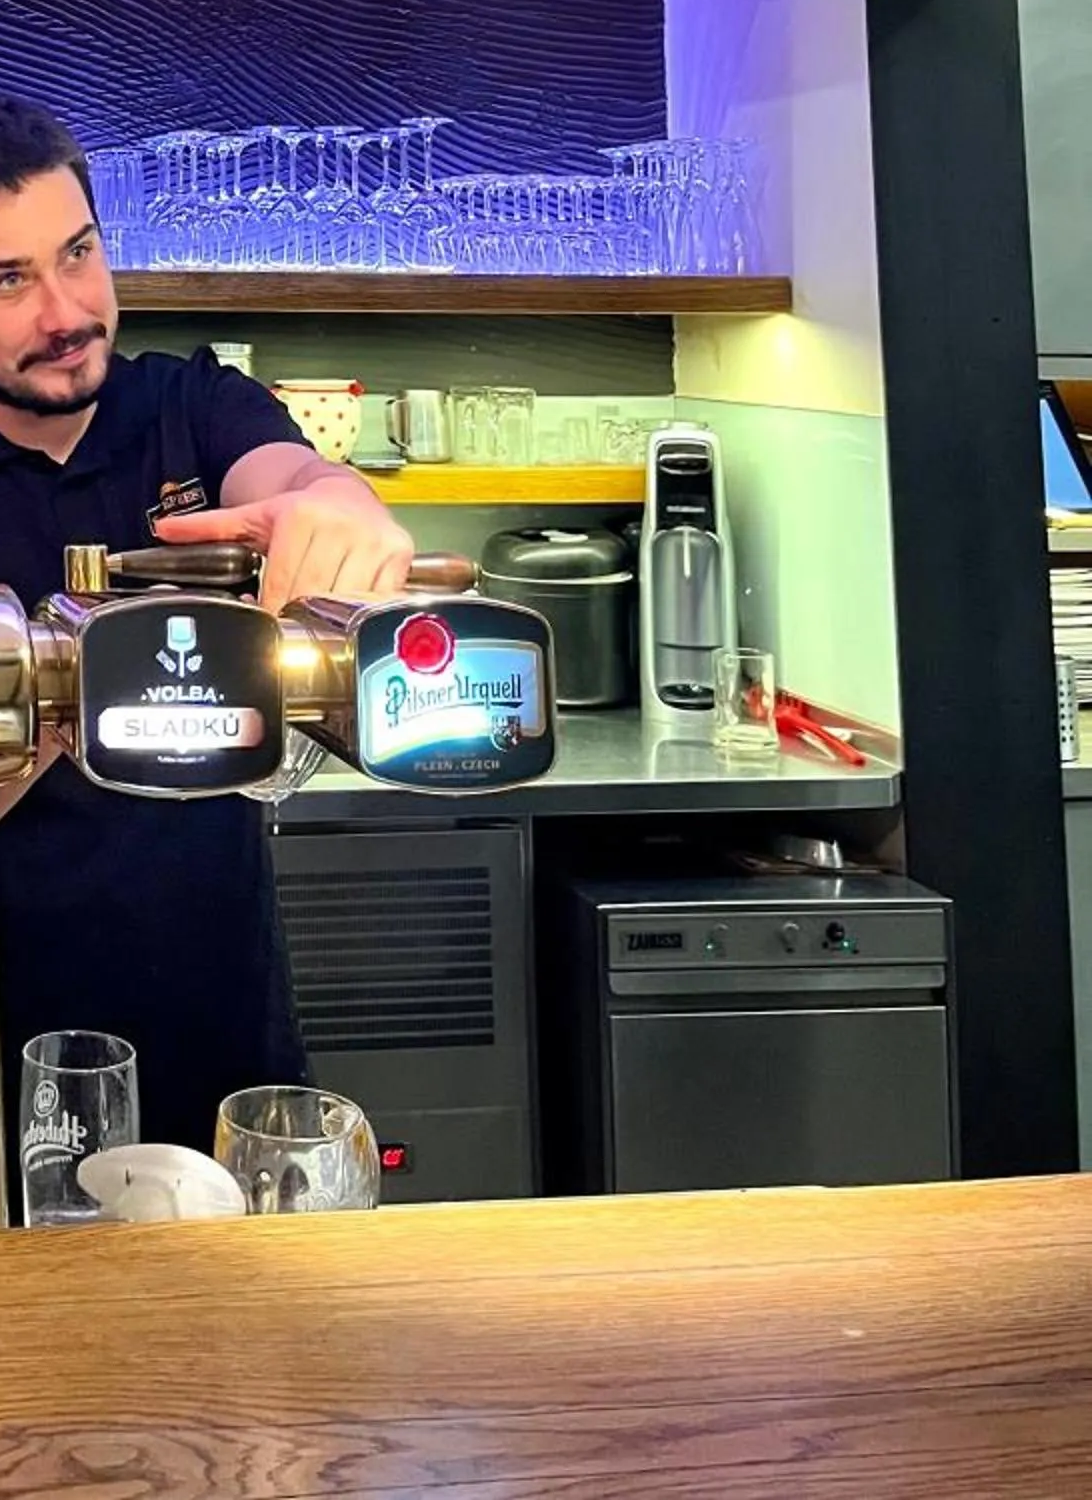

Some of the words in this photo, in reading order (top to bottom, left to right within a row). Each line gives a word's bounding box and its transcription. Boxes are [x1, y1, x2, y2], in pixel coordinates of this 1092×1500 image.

[145, 685, 218, 703] VOLBA
[384, 675, 456, 728] Pilsner
[454, 673, 523, 710] Urquell
